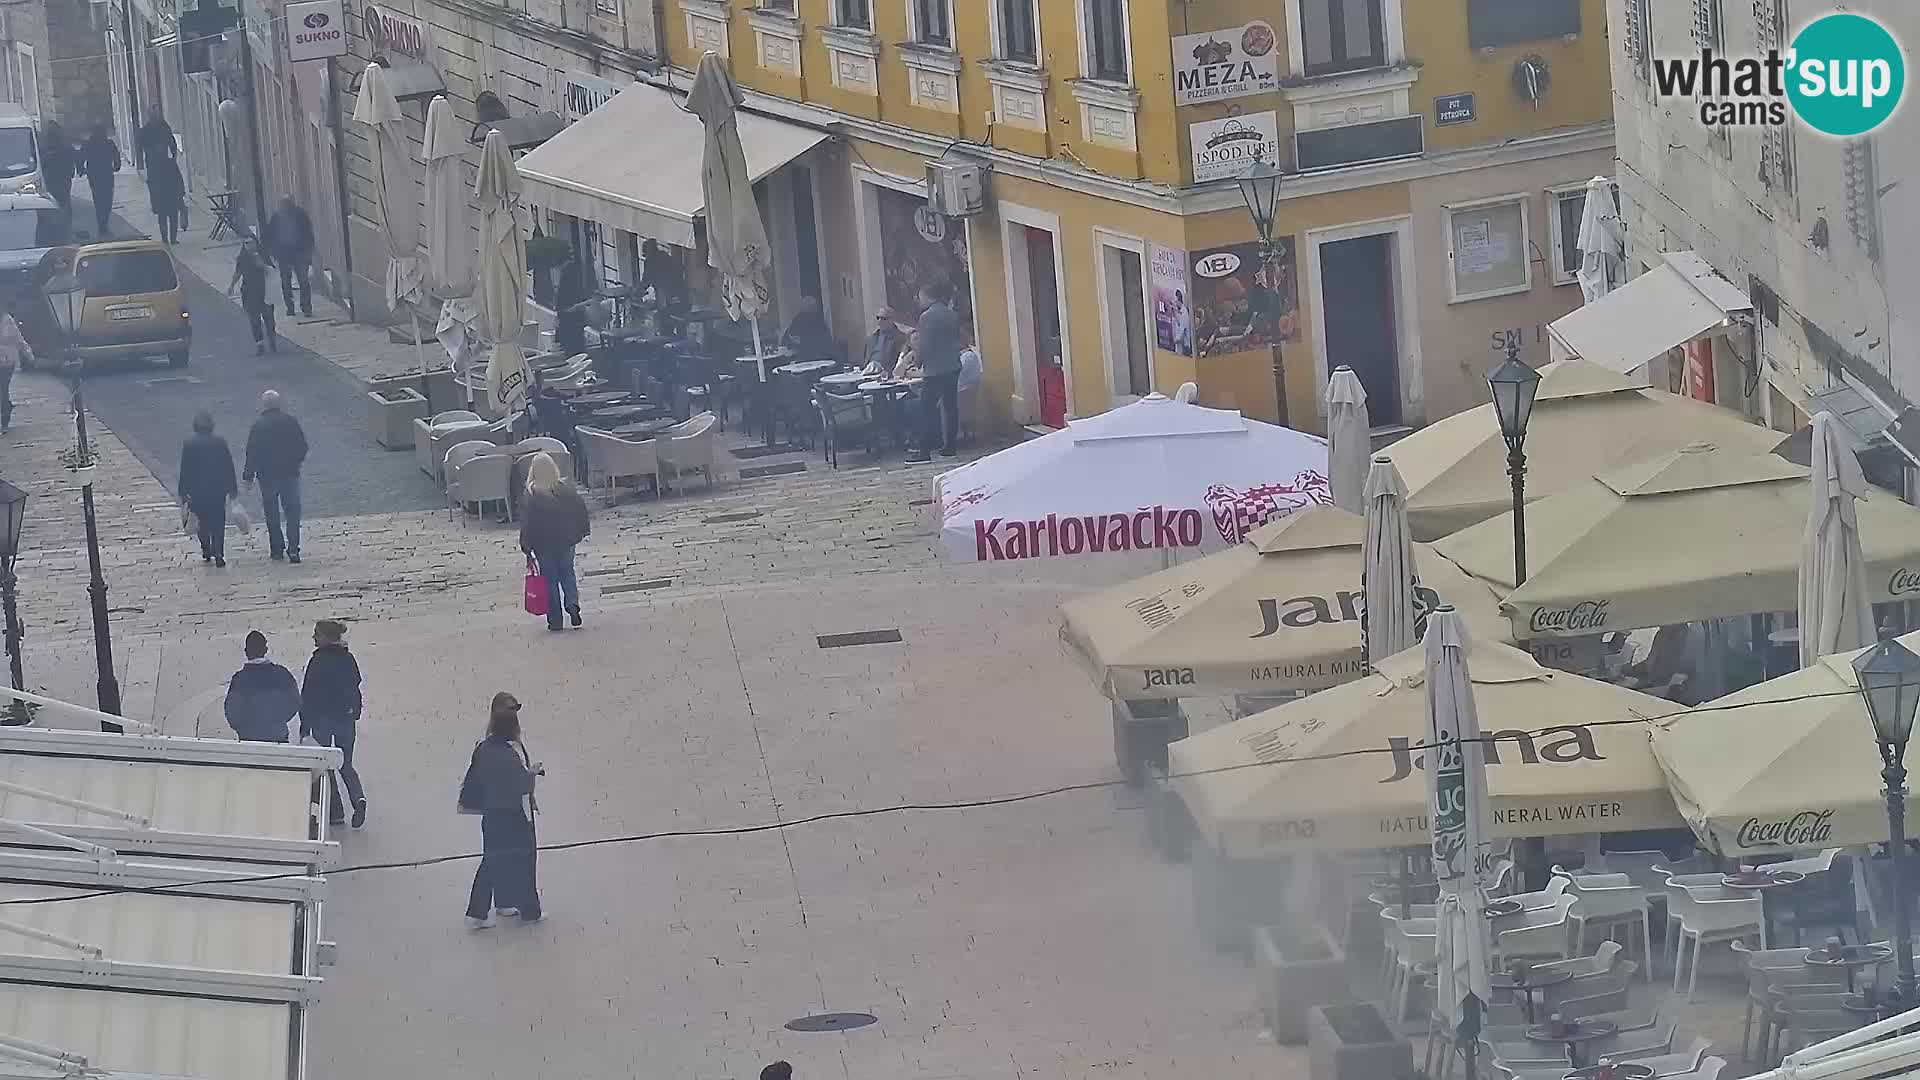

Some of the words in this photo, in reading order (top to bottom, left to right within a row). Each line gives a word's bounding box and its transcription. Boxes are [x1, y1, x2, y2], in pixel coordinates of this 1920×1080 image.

[295, 30, 340, 44] SUKNO
[382, 14, 421, 51] SUKNO
[1178, 61, 1257, 91] MEZA
[1187, 86, 1220, 99] PIZZERIA
[1228, 84, 1248, 93] GRILL
[1196, 146, 1242, 165] ISPOD
[973, 505, 1203, 561] Karlovačko
[1251, 663, 1325, 681] NATURAL
[1331, 660, 1361, 675] MIN
[1377, 722, 1607, 784] Jna
[1379, 815, 1428, 833] NATU
[1494, 808, 1554, 825] NERAL
[1558, 802, 1622, 820] WATER
[1737, 809, 1836, 848] Coca-Cola
